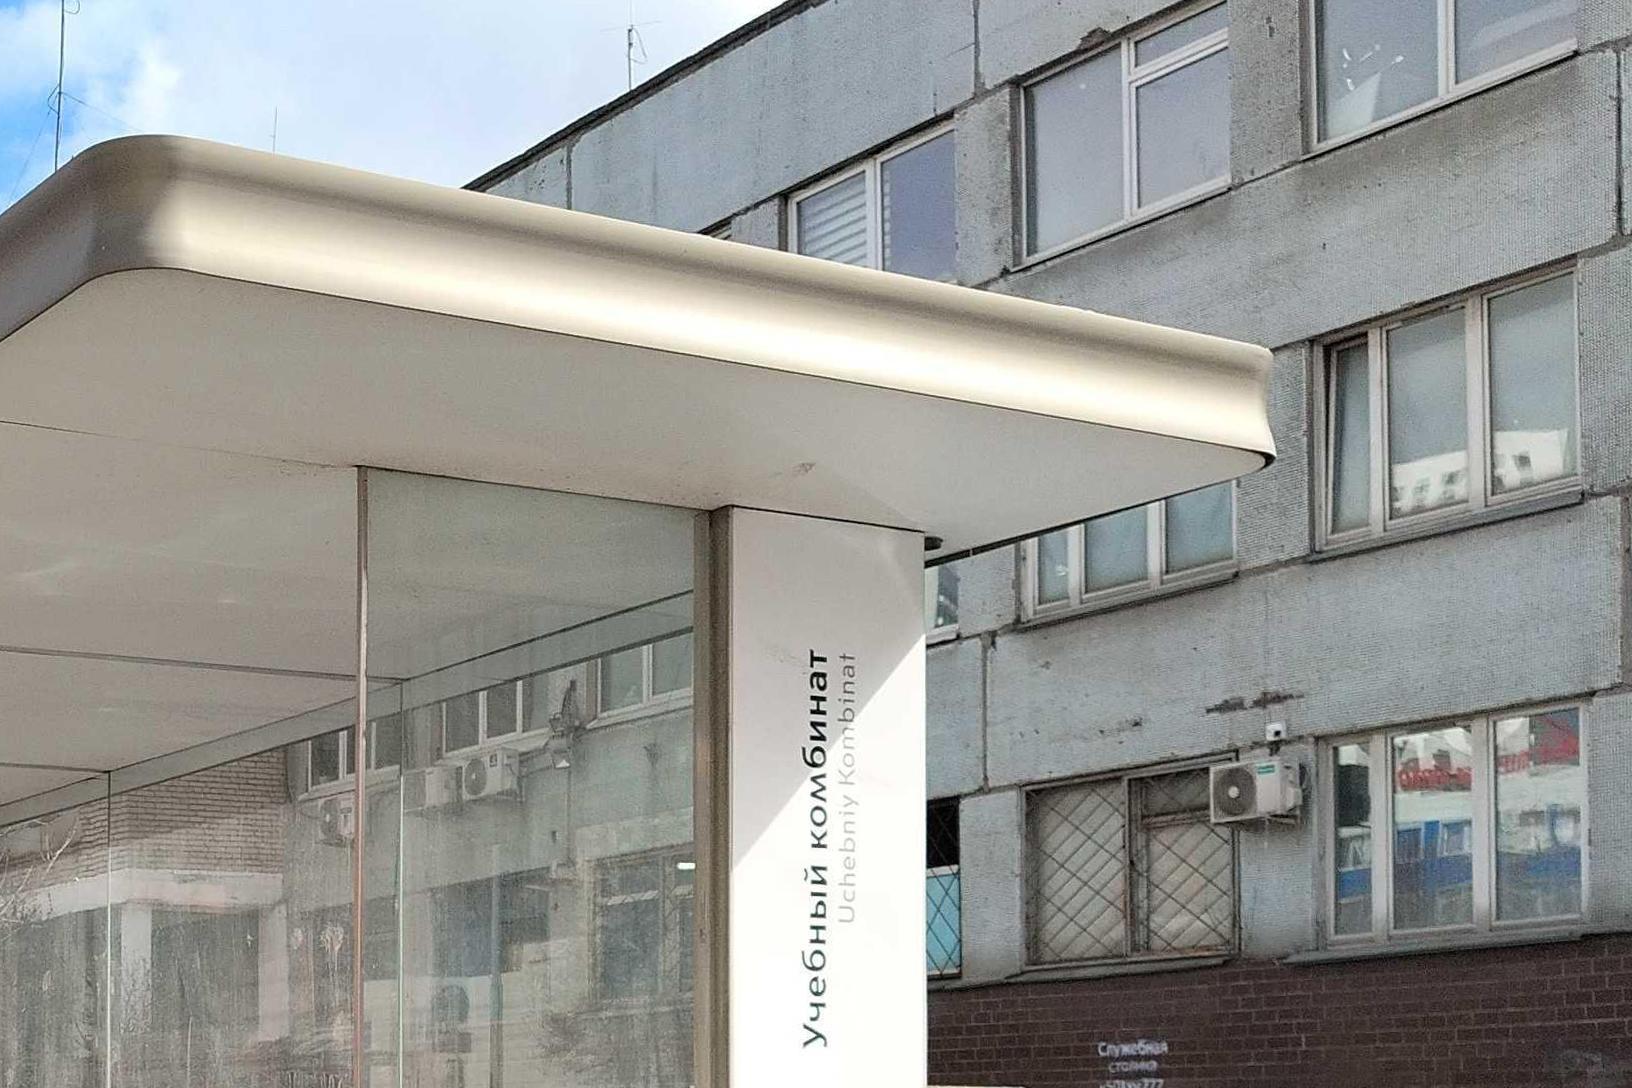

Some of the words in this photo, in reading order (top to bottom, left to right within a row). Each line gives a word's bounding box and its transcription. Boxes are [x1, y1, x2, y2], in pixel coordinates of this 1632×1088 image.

[801, 649, 827, 848] комбинат
[838, 653, 856, 785] Kombinat
[838, 794, 859, 923] Uchebniy
[802, 865, 827, 1048] Учебный
